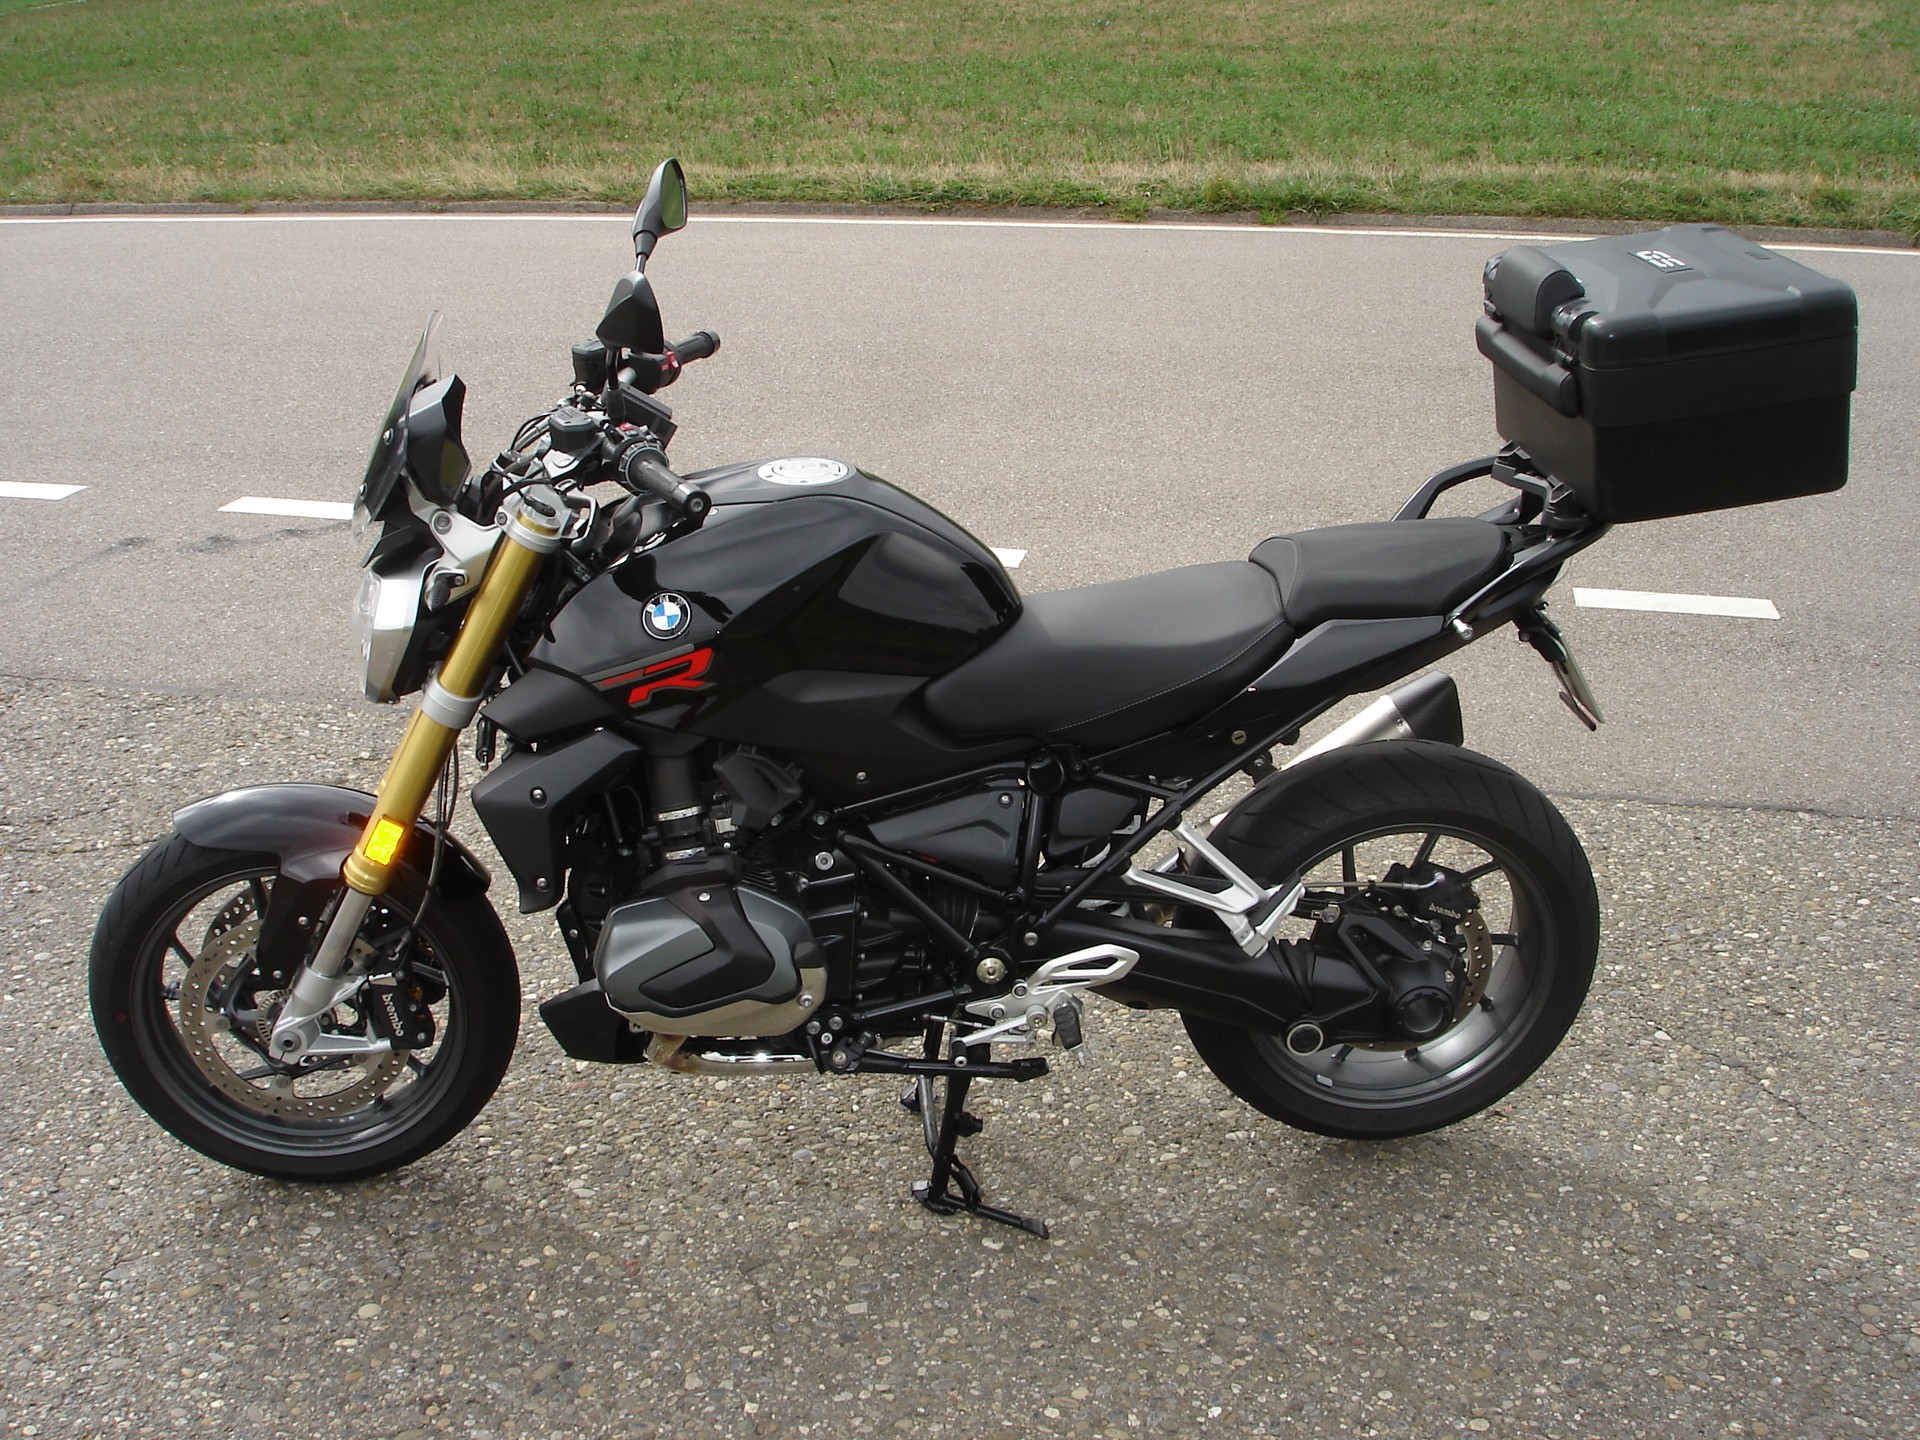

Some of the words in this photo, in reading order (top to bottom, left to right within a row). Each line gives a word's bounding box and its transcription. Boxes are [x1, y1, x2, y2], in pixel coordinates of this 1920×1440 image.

[628, 647, 714, 705] R
[1428, 902, 1461, 919] brembo
[381, 993, 404, 1037] brembo
